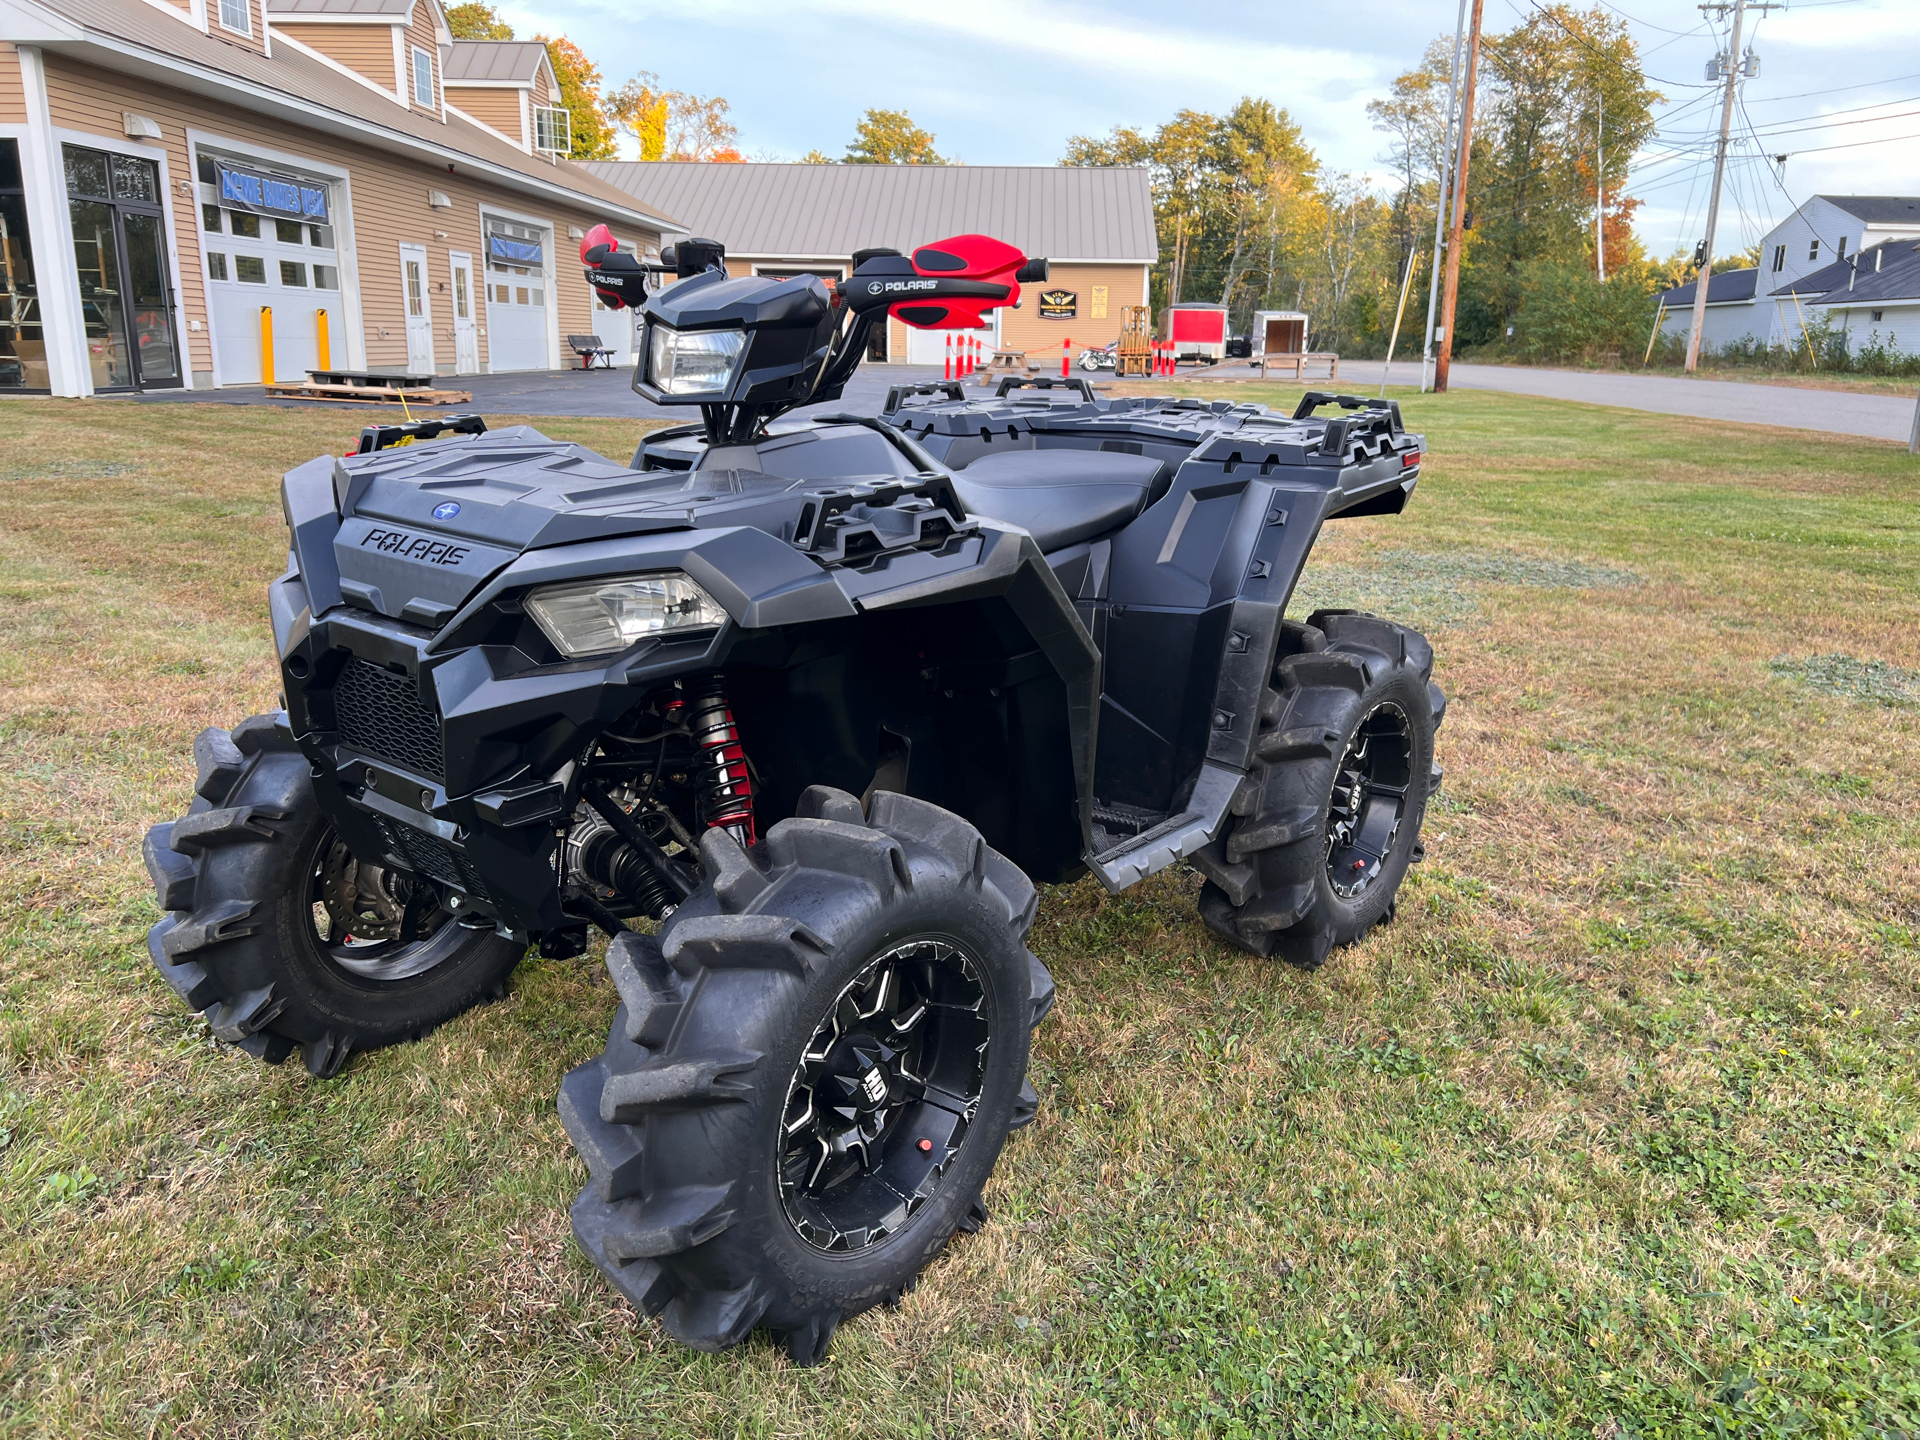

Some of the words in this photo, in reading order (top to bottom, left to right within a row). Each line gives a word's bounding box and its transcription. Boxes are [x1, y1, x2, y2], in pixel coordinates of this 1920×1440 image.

[222, 169, 263, 206] ACME
[262, 178, 301, 214] BIKES
[300, 187, 326, 218] USA
[595, 275, 624, 286] POLARIS
[885, 280, 938, 292] POLARIS
[360, 528, 471, 566] POLARIS
[864, 1066, 887, 1102] HD
